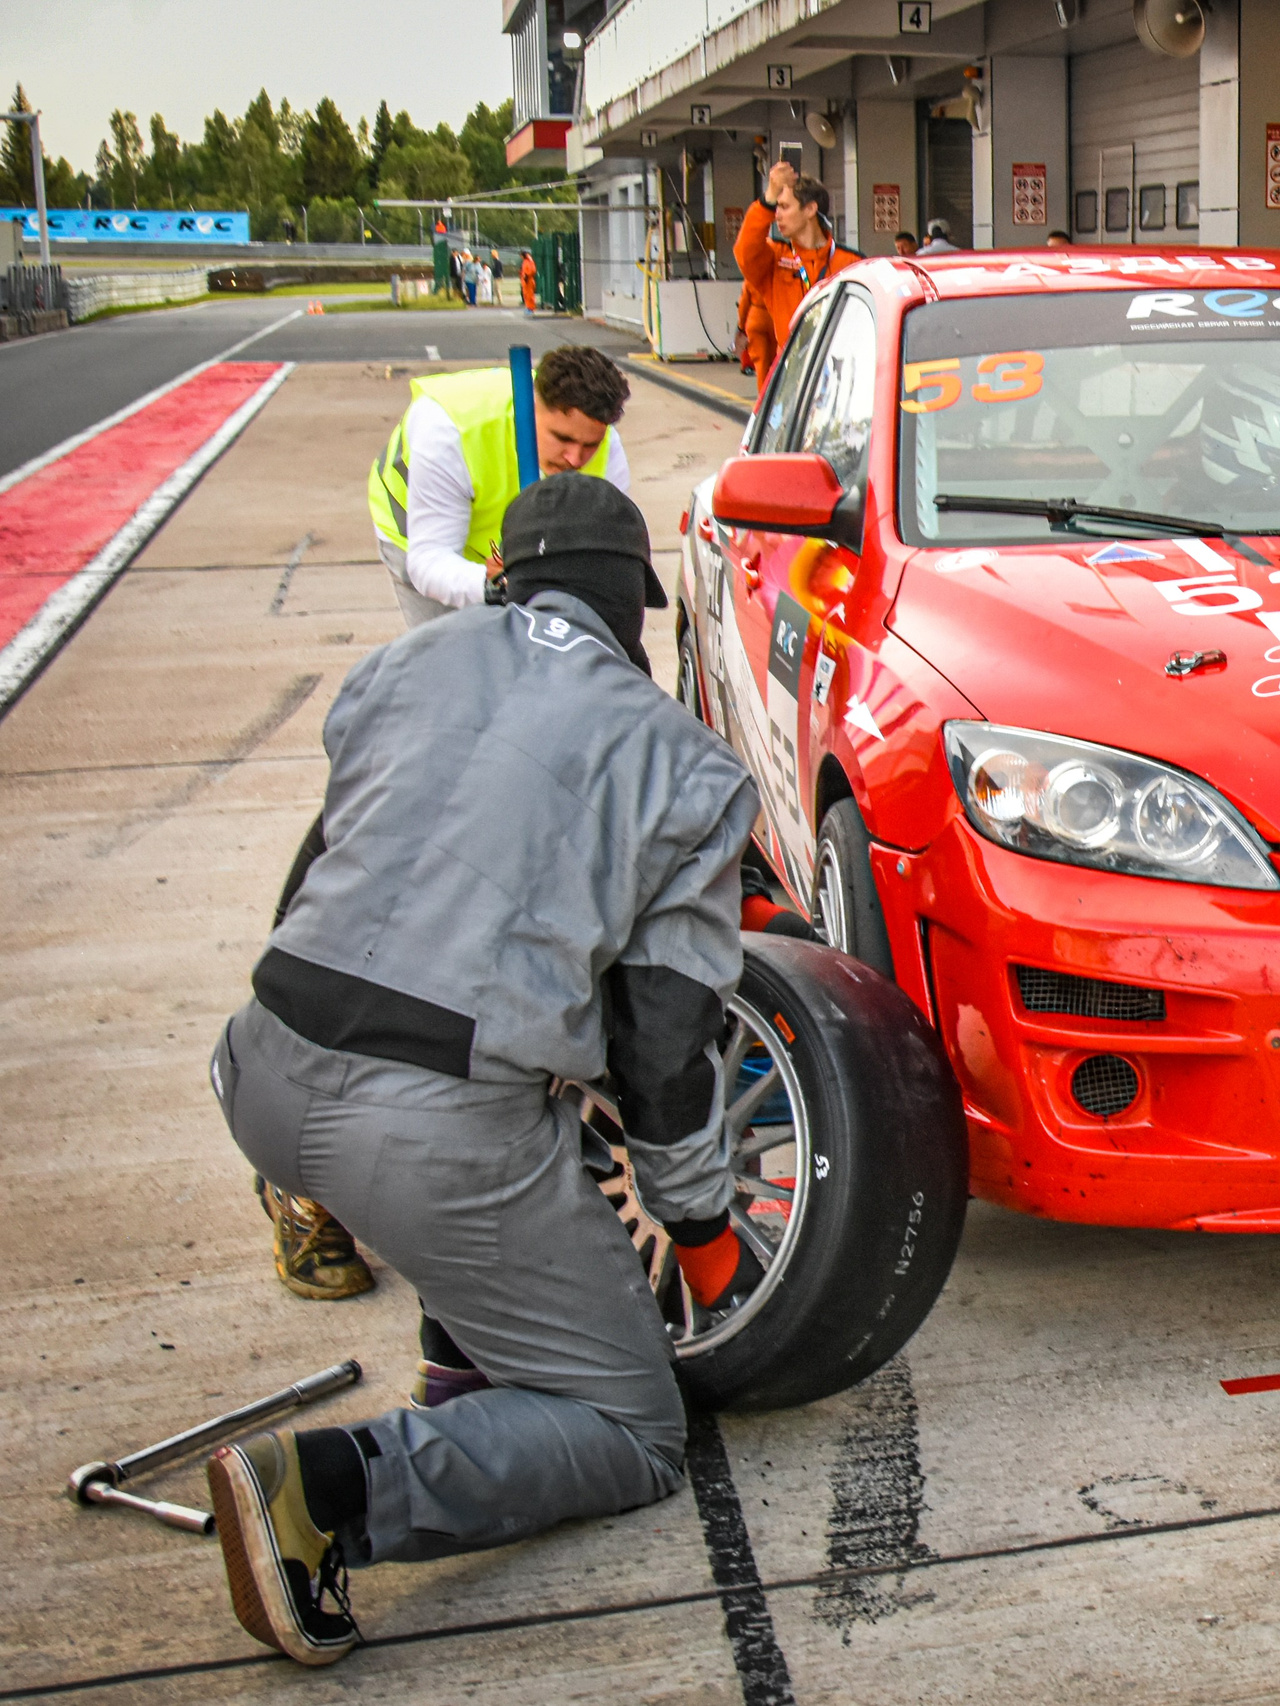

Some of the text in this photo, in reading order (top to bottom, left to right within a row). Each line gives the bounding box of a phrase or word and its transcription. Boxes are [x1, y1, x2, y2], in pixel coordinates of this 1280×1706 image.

[908, 7, 922, 29] 4
[776, 68, 785, 86] 3
[1130, 321, 1195, 332] РОССИЙСКАЯ
[1198, 320, 1231, 329] СЕРИЯ
[1233, 320, 1265, 328] ГОНОК
[900, 351, 1045, 413] 53
[814, 1153, 830, 1181] 53
[894, 1191, 925, 1275] N2756
